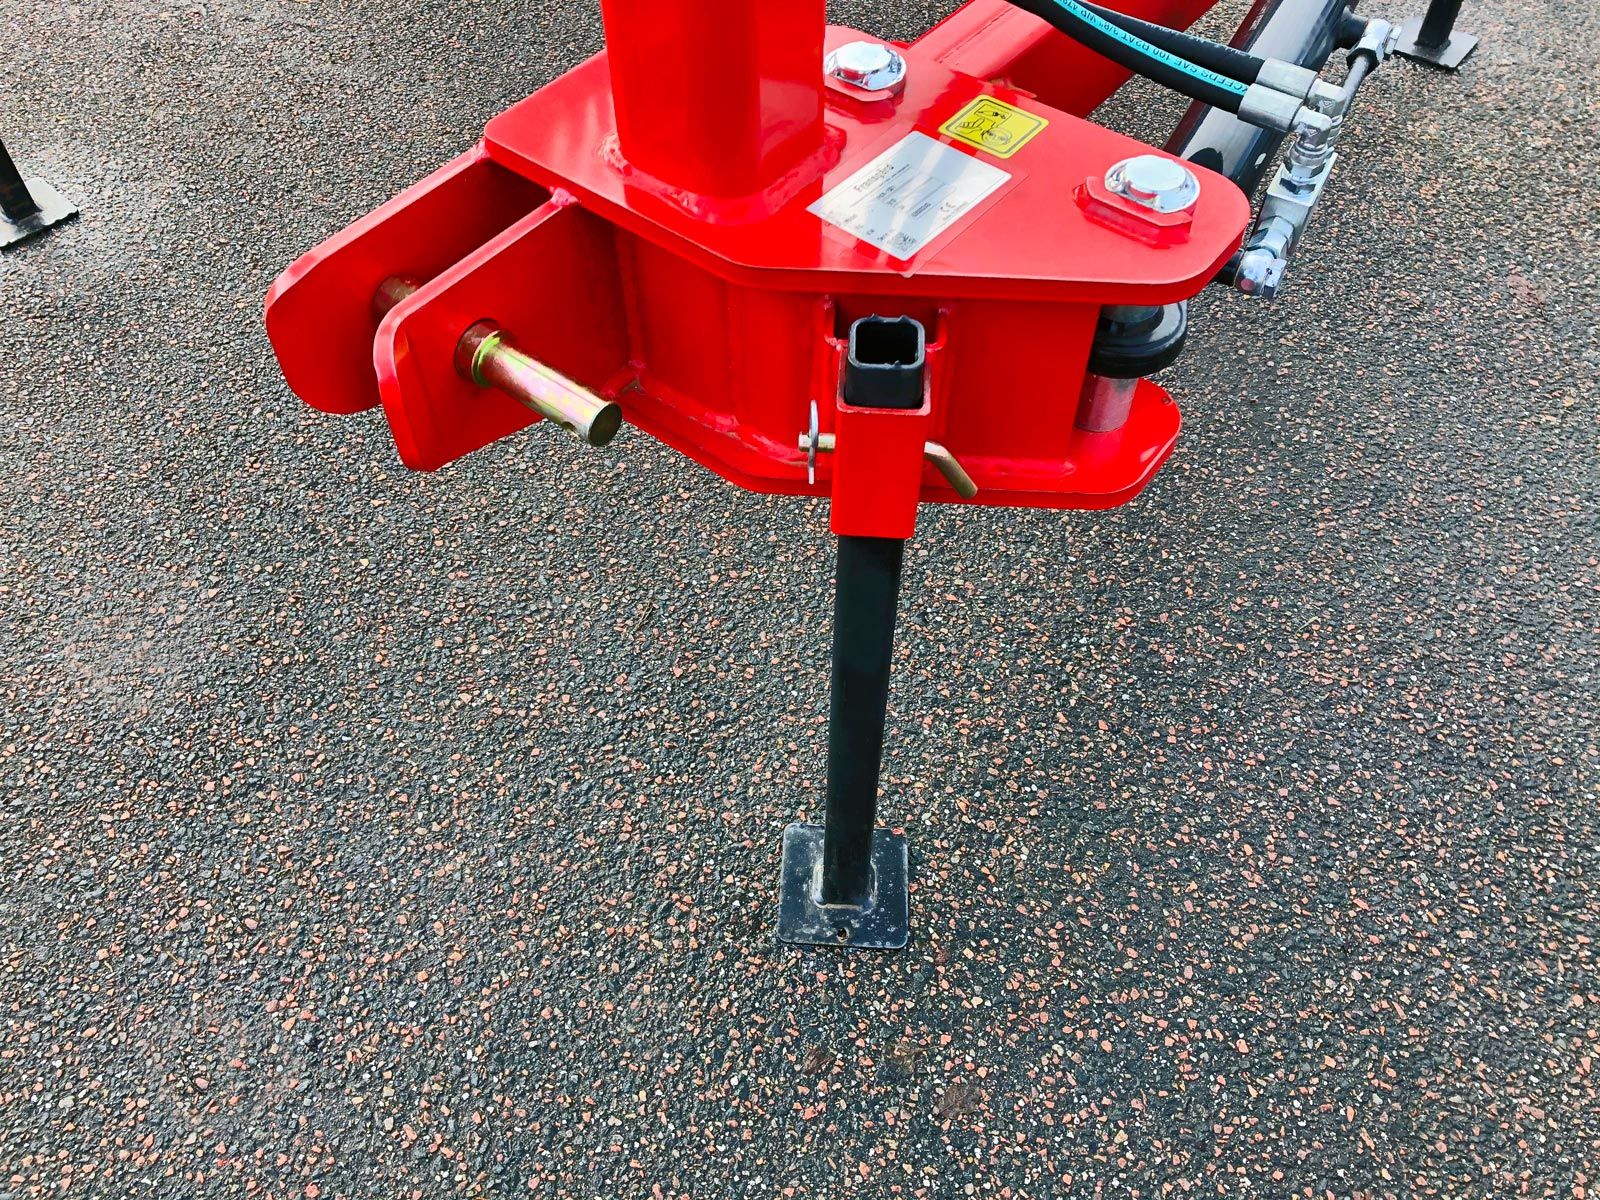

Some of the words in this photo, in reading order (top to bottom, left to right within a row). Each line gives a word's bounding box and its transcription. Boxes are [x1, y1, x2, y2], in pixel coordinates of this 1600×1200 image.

[1121, 33, 1149, 51] R2AT
[1153, 48, 1170, 61] 100
[1174, 58, 1197, 73] SAE
